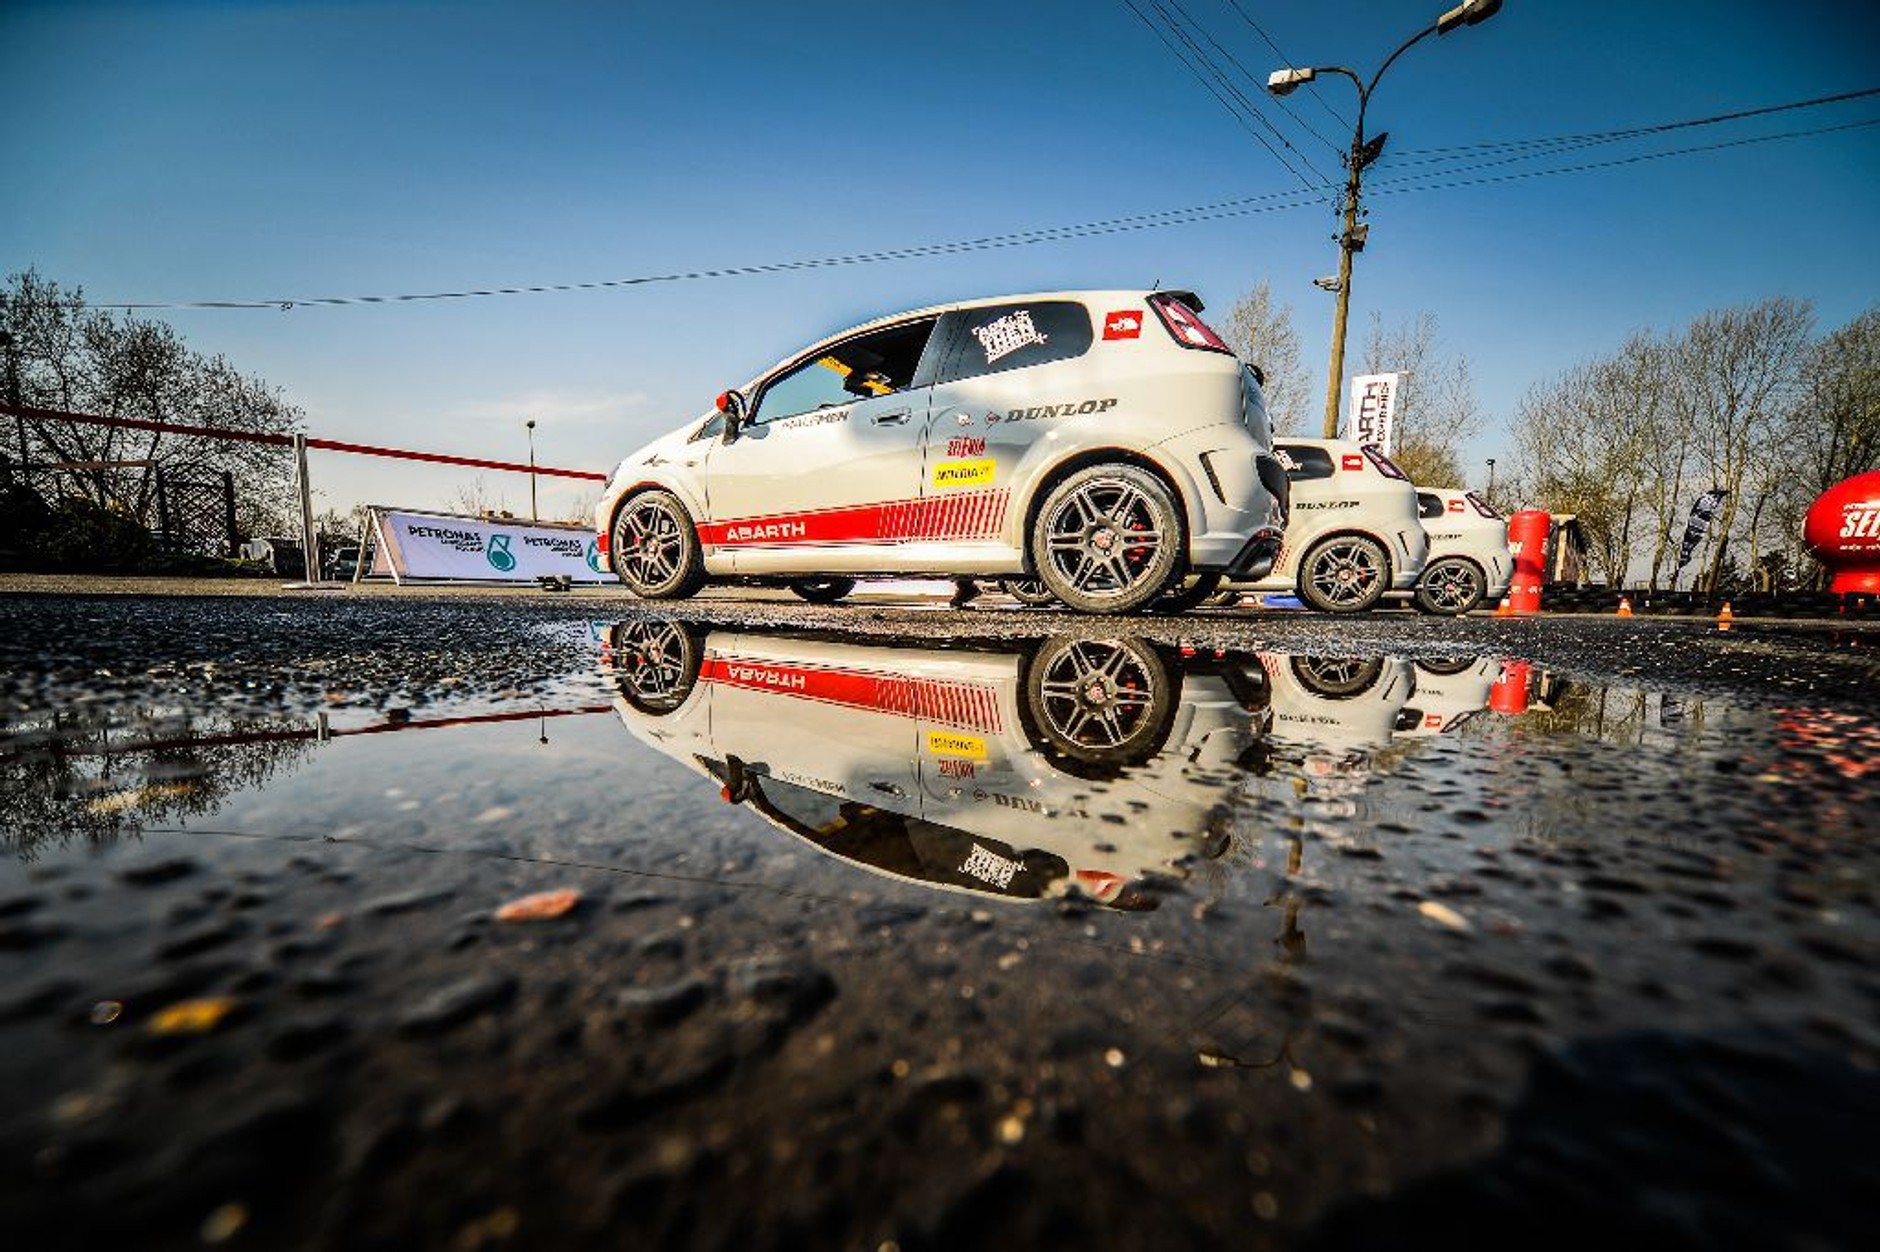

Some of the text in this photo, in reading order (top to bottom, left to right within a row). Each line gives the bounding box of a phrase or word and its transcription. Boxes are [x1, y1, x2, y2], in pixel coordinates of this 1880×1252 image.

[1004, 398, 1118, 424] DUNLOP
[408, 525, 482, 541] PETRONAS
[727, 521, 806, 541] ABARTH
[523, 536, 581, 549] PETRONAS
